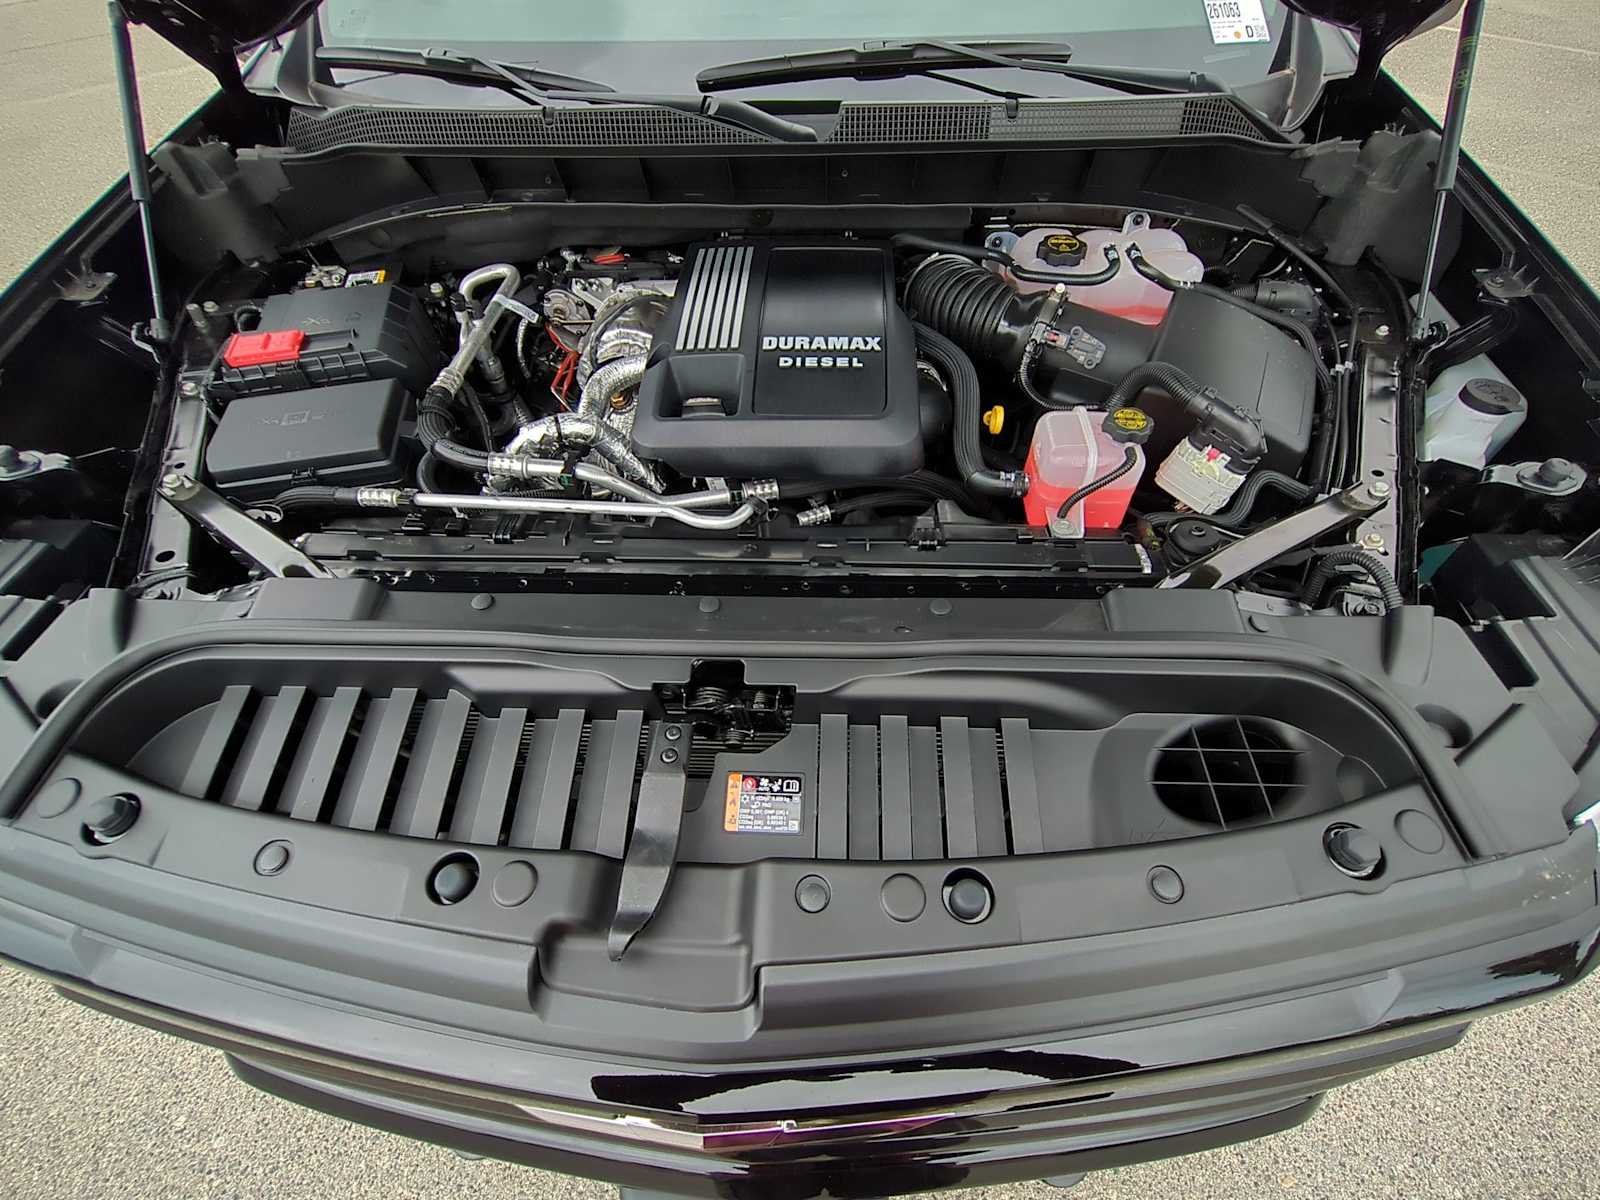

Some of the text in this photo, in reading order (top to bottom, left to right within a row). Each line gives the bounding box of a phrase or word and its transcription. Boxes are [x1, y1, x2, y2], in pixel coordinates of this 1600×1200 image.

[1207, 2, 1241, 19] 261063
[762, 336, 882, 351] DURAMAX
[778, 356, 864, 368] DIESEL
